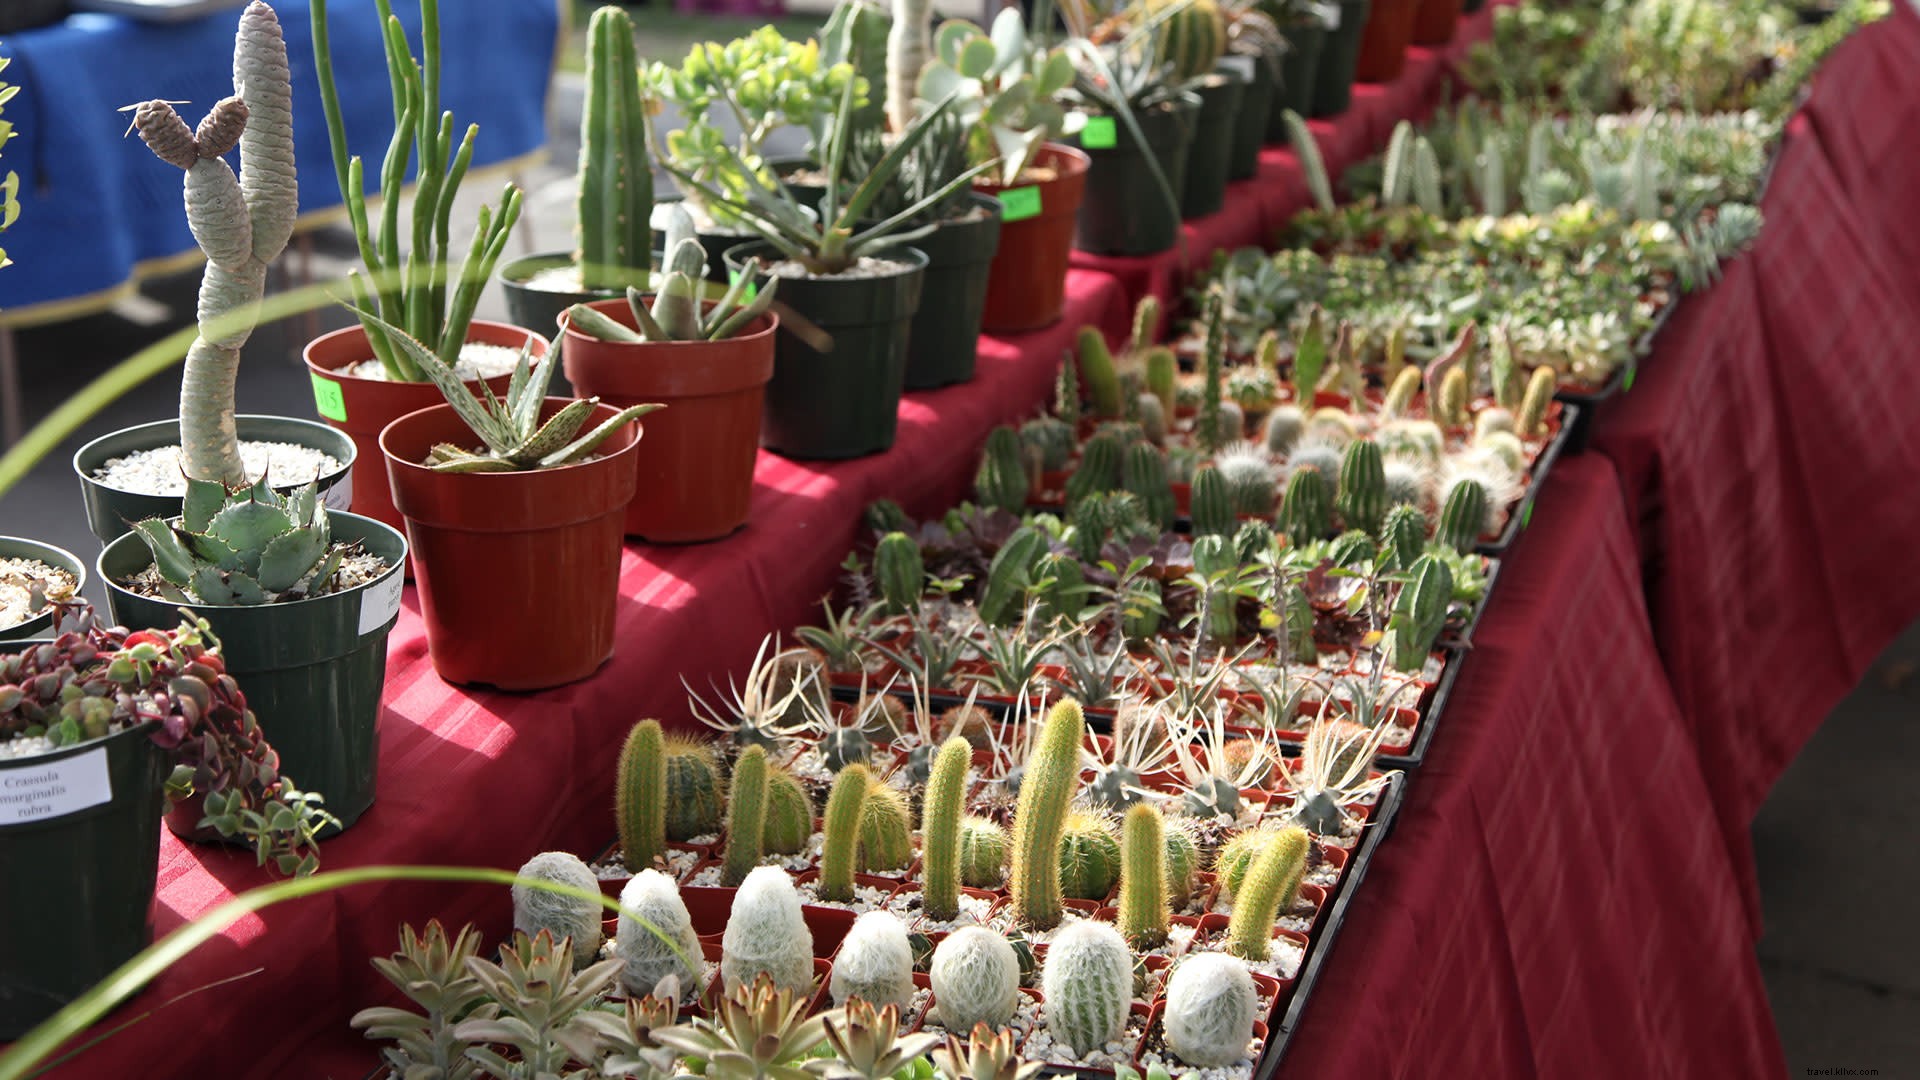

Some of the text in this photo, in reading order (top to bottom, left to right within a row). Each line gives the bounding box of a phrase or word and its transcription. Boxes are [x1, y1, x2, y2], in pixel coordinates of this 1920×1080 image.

[4, 771, 59, 788] Crassula
[0, 786, 67, 804] marginalis
[18, 805, 52, 817] rubra
